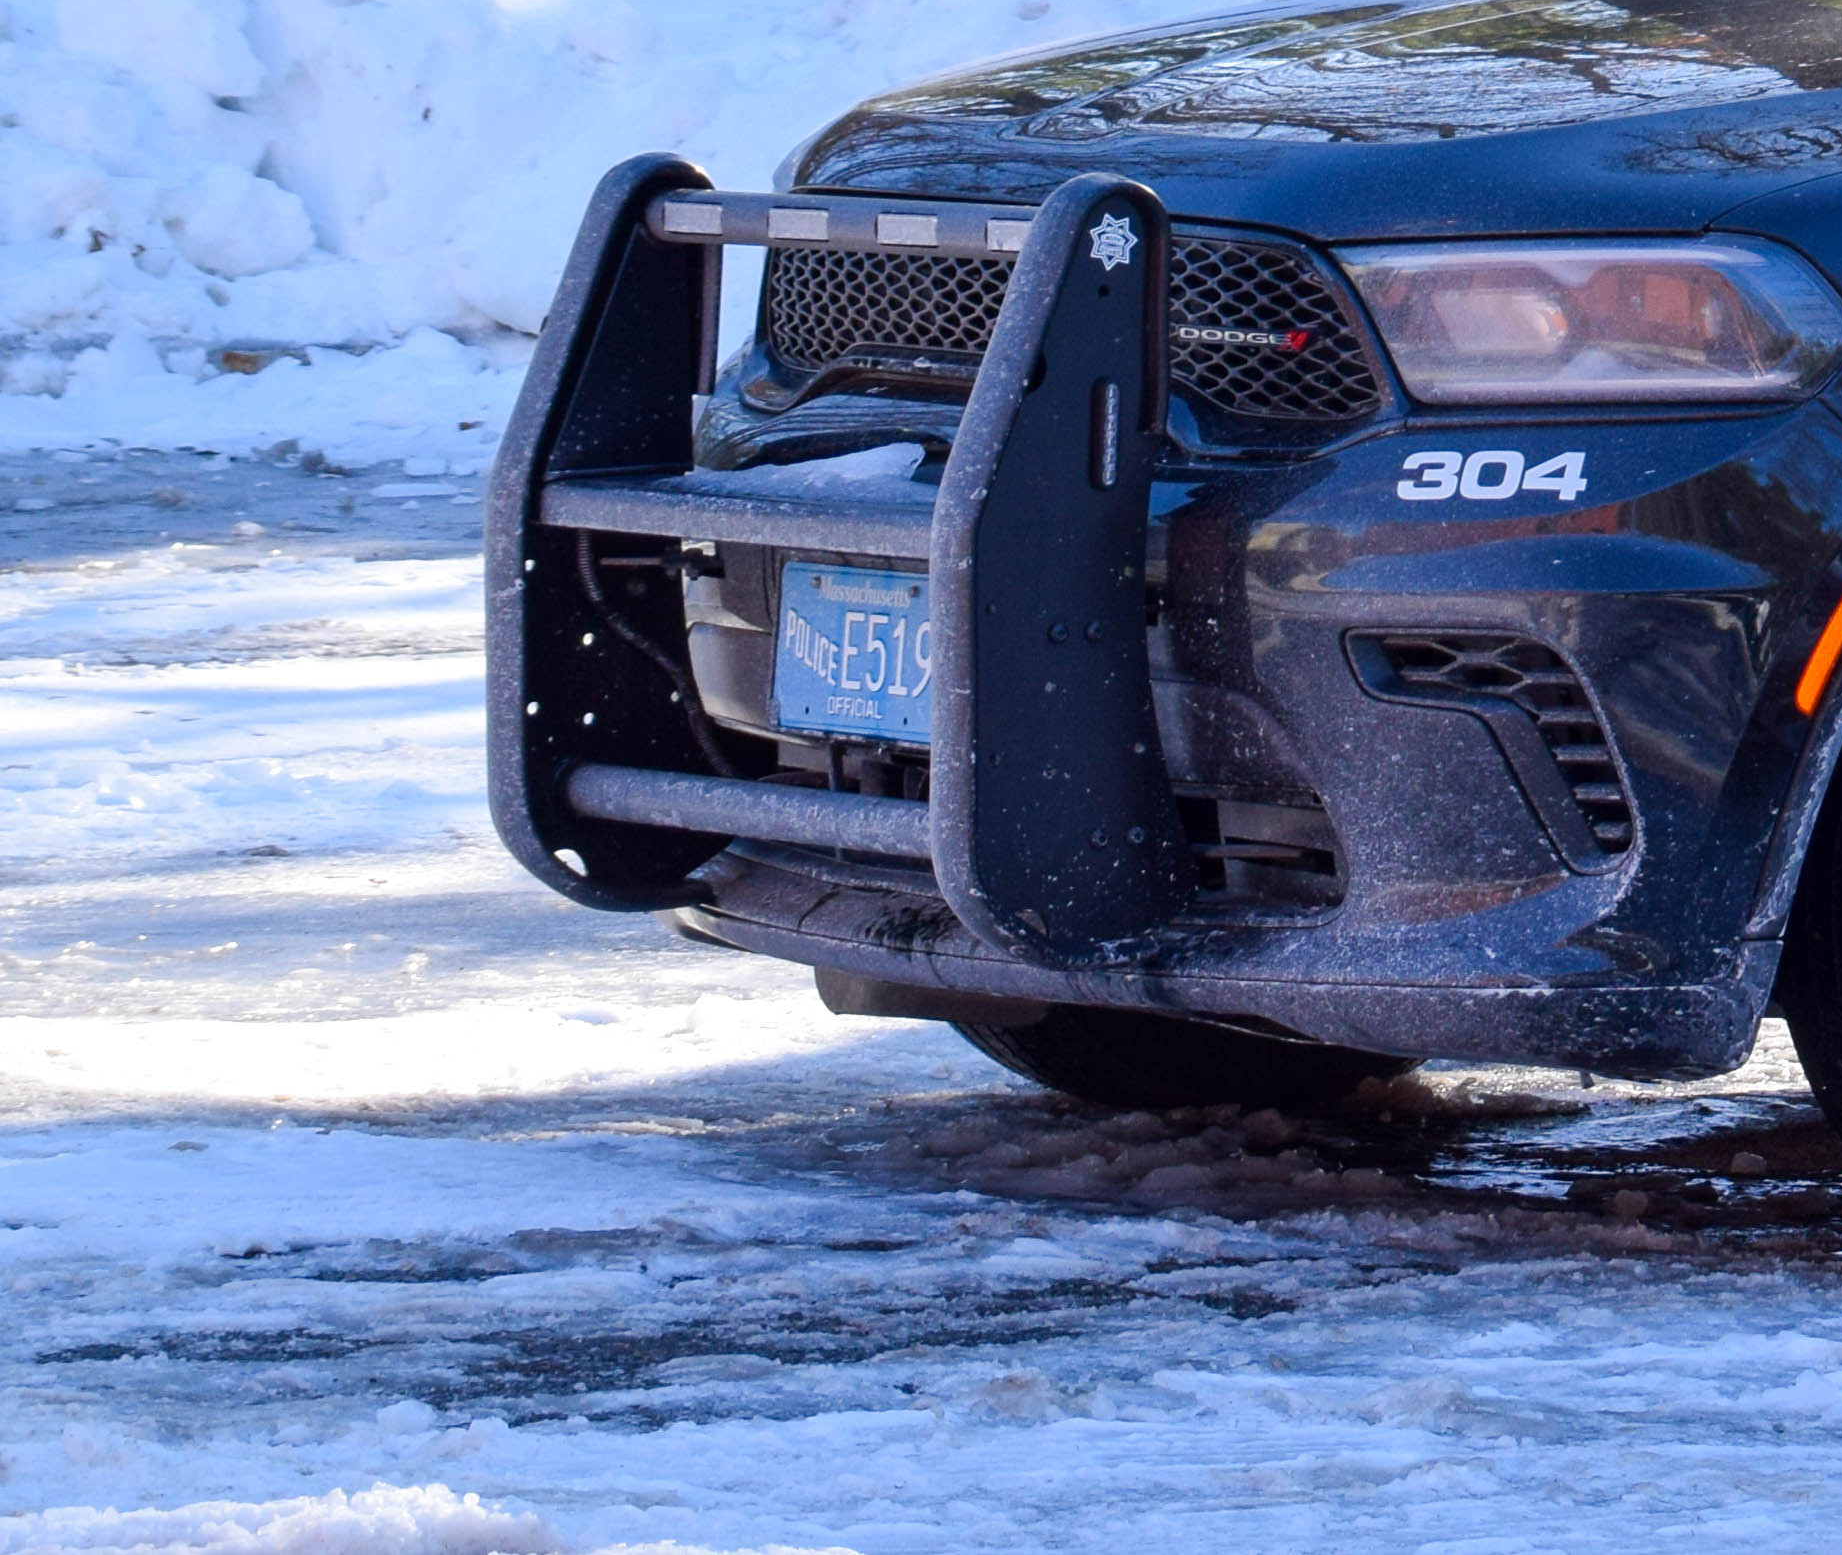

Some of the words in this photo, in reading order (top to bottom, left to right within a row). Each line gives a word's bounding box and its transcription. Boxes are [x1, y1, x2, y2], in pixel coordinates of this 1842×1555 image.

[1179, 327, 1292, 345] DODGE
[1396, 450, 1587, 501] 304
[820, 574, 912, 608] Massachusetts
[786, 608, 840, 686] POLICE
[841, 611, 932, 698] E519
[827, 696, 883, 719] OFFICIAL
